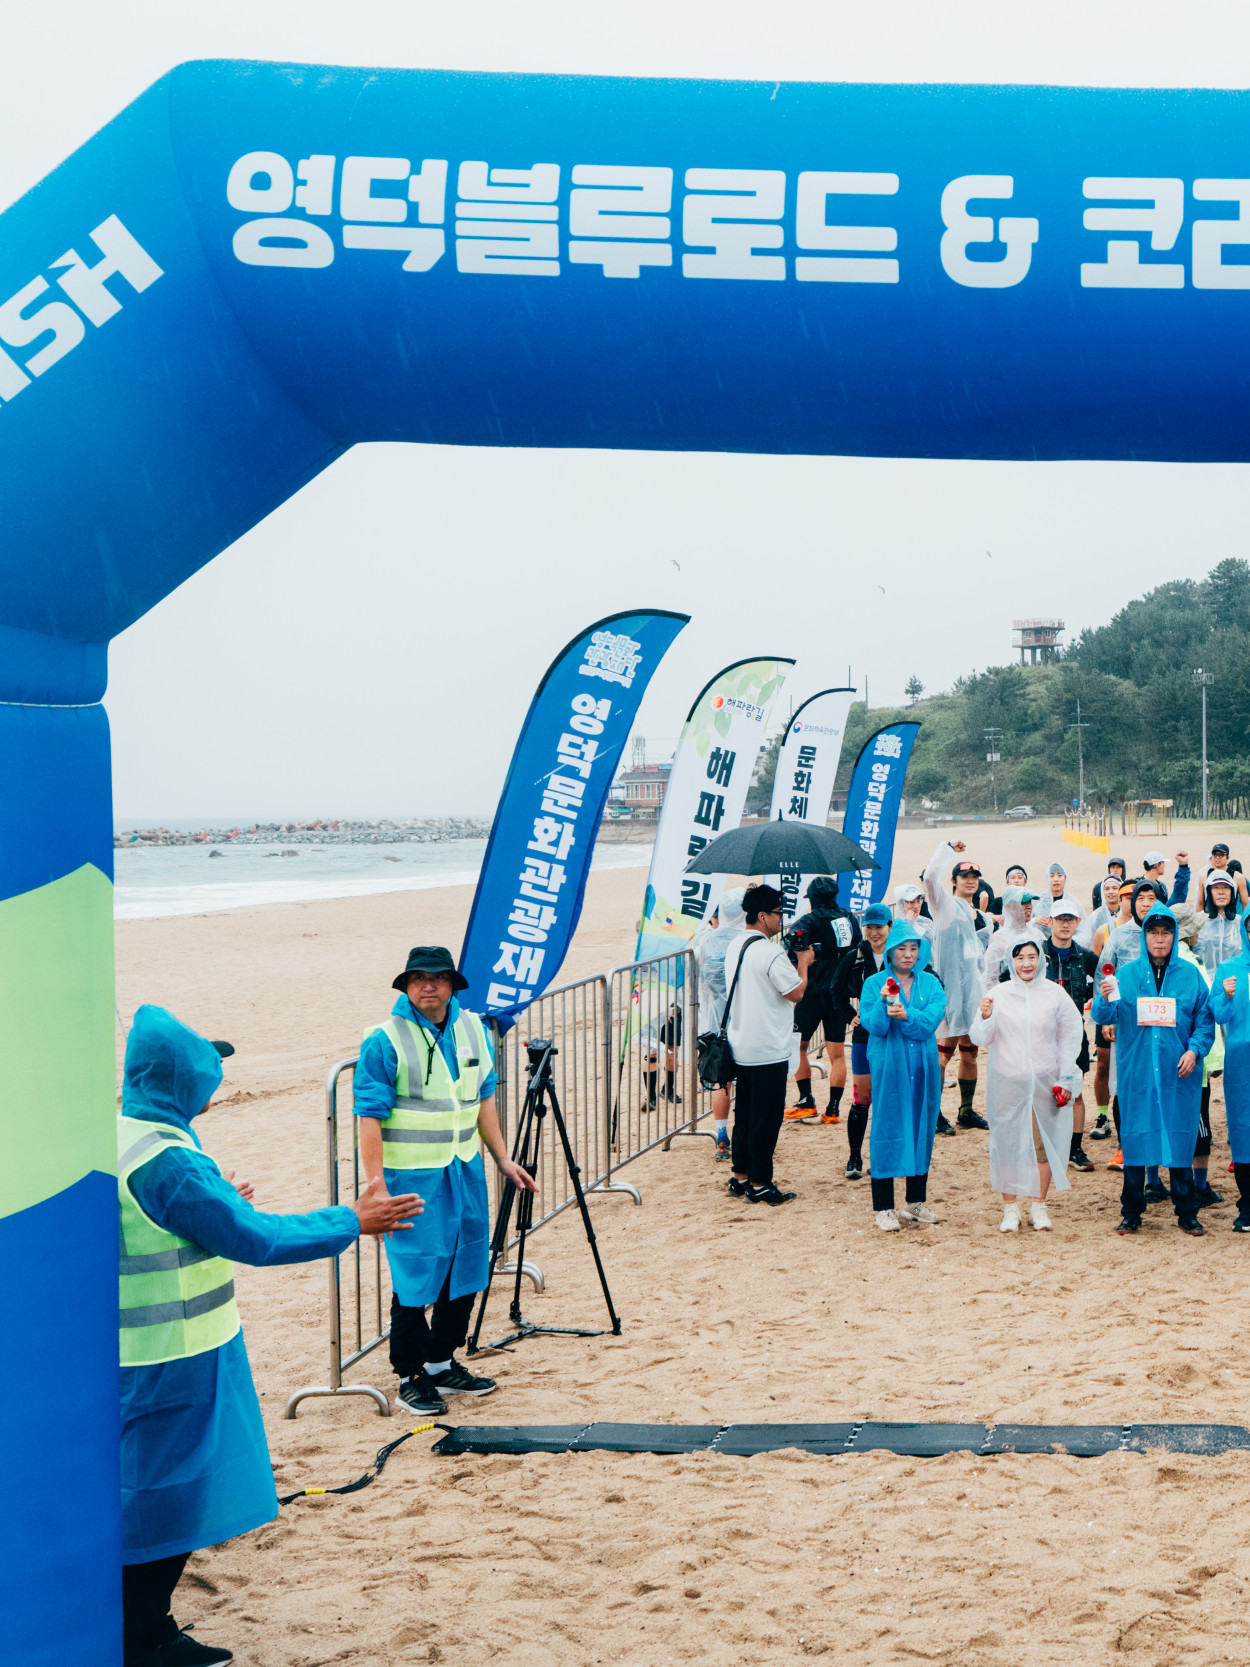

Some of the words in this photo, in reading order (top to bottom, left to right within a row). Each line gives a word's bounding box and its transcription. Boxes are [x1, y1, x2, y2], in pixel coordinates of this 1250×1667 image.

[227, 151, 900, 284] 영덕블루로드
[940, 174, 1039, 288] &
[727, 697, 765, 722] 해파랑길
[1147, 1004, 1166, 1014] 173
